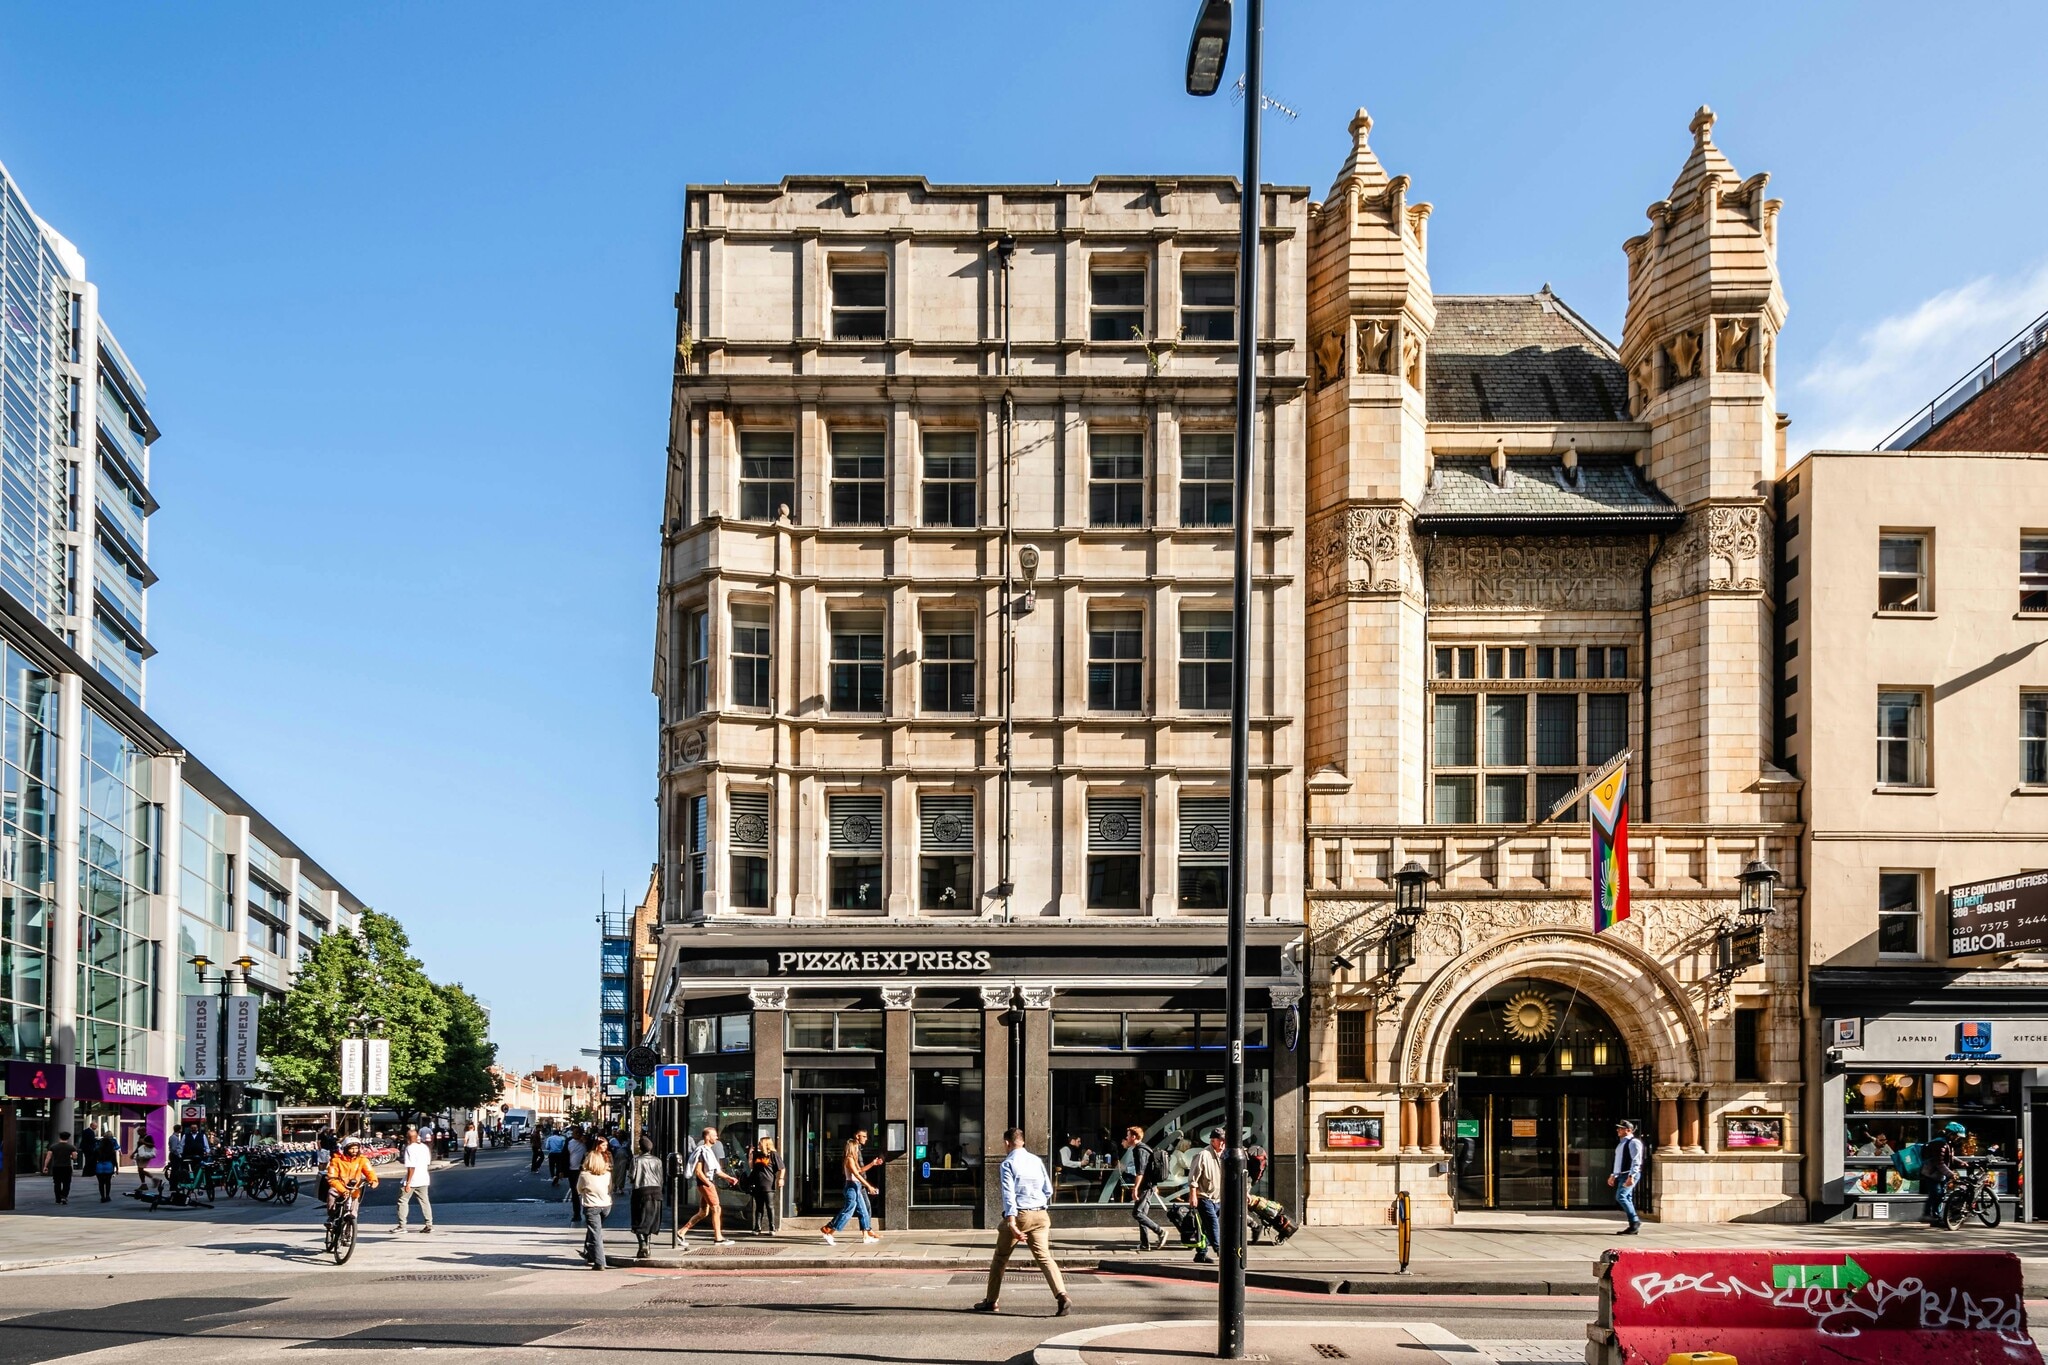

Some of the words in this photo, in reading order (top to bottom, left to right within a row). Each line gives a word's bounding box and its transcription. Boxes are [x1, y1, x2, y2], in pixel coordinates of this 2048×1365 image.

[1952, 887, 1971, 899] SELF
[1971, 880, 2015, 896] CONTAINED
[2016, 874, 2048, 889] OFFICES
[1953, 898, 1963, 908] TO
[1963, 894, 1984, 906] RENT
[1976, 902, 1993, 914] 950
[1994, 900, 2006, 912] SQ
[2006, 899, 2016, 910] FT
[1953, 926, 1973, 935] 020
[1981, 920, 2009, 932] 7375
[2018, 914, 2047, 927] 3444
[117, 1078, 148, 1097] NatWest
